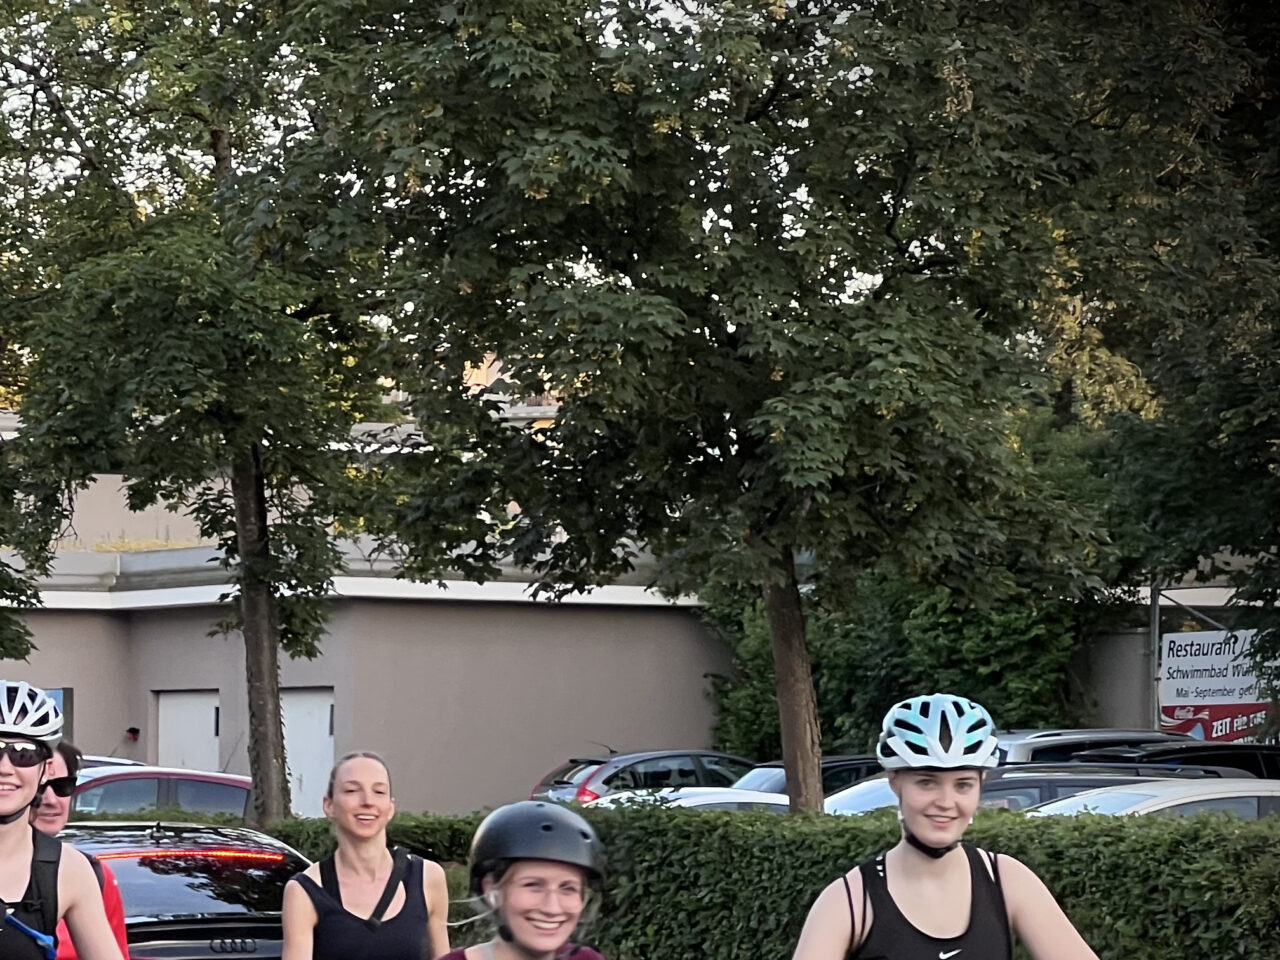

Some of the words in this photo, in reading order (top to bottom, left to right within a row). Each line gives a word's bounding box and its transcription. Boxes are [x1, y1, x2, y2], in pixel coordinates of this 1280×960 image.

[1167, 640, 1236, 658] Restaurant
[1166, 663, 1229, 680] Schwimmbad
[1212, 718, 1231, 738] ZEIT
